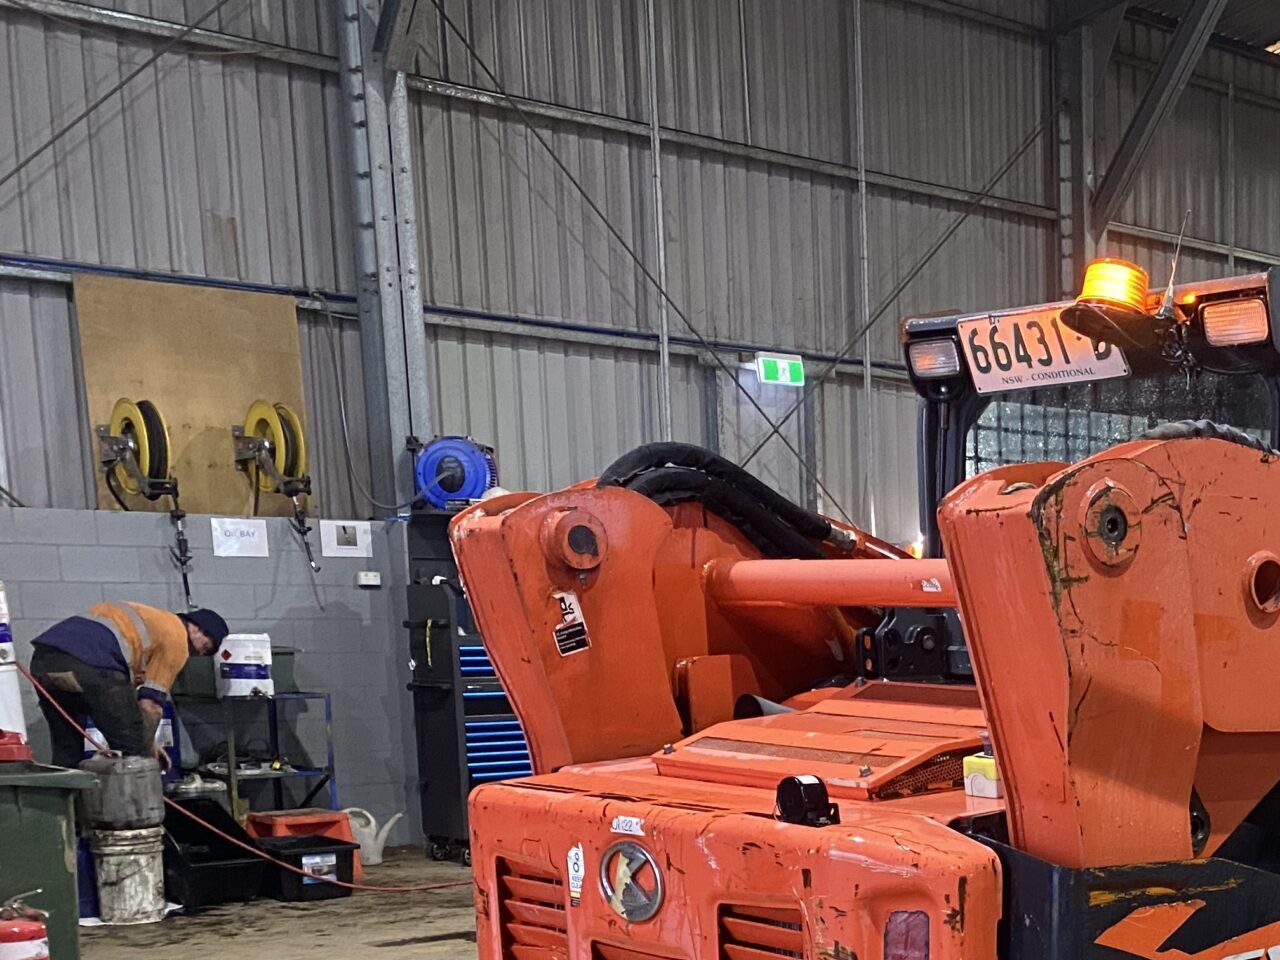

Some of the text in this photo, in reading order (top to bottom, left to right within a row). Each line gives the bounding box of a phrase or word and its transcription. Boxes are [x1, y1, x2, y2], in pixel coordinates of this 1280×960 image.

[968, 317, 1071, 374] 66431
[1002, 375, 1023, 385] NSW
[1031, 367, 1096, 382] CONDITIONAL
